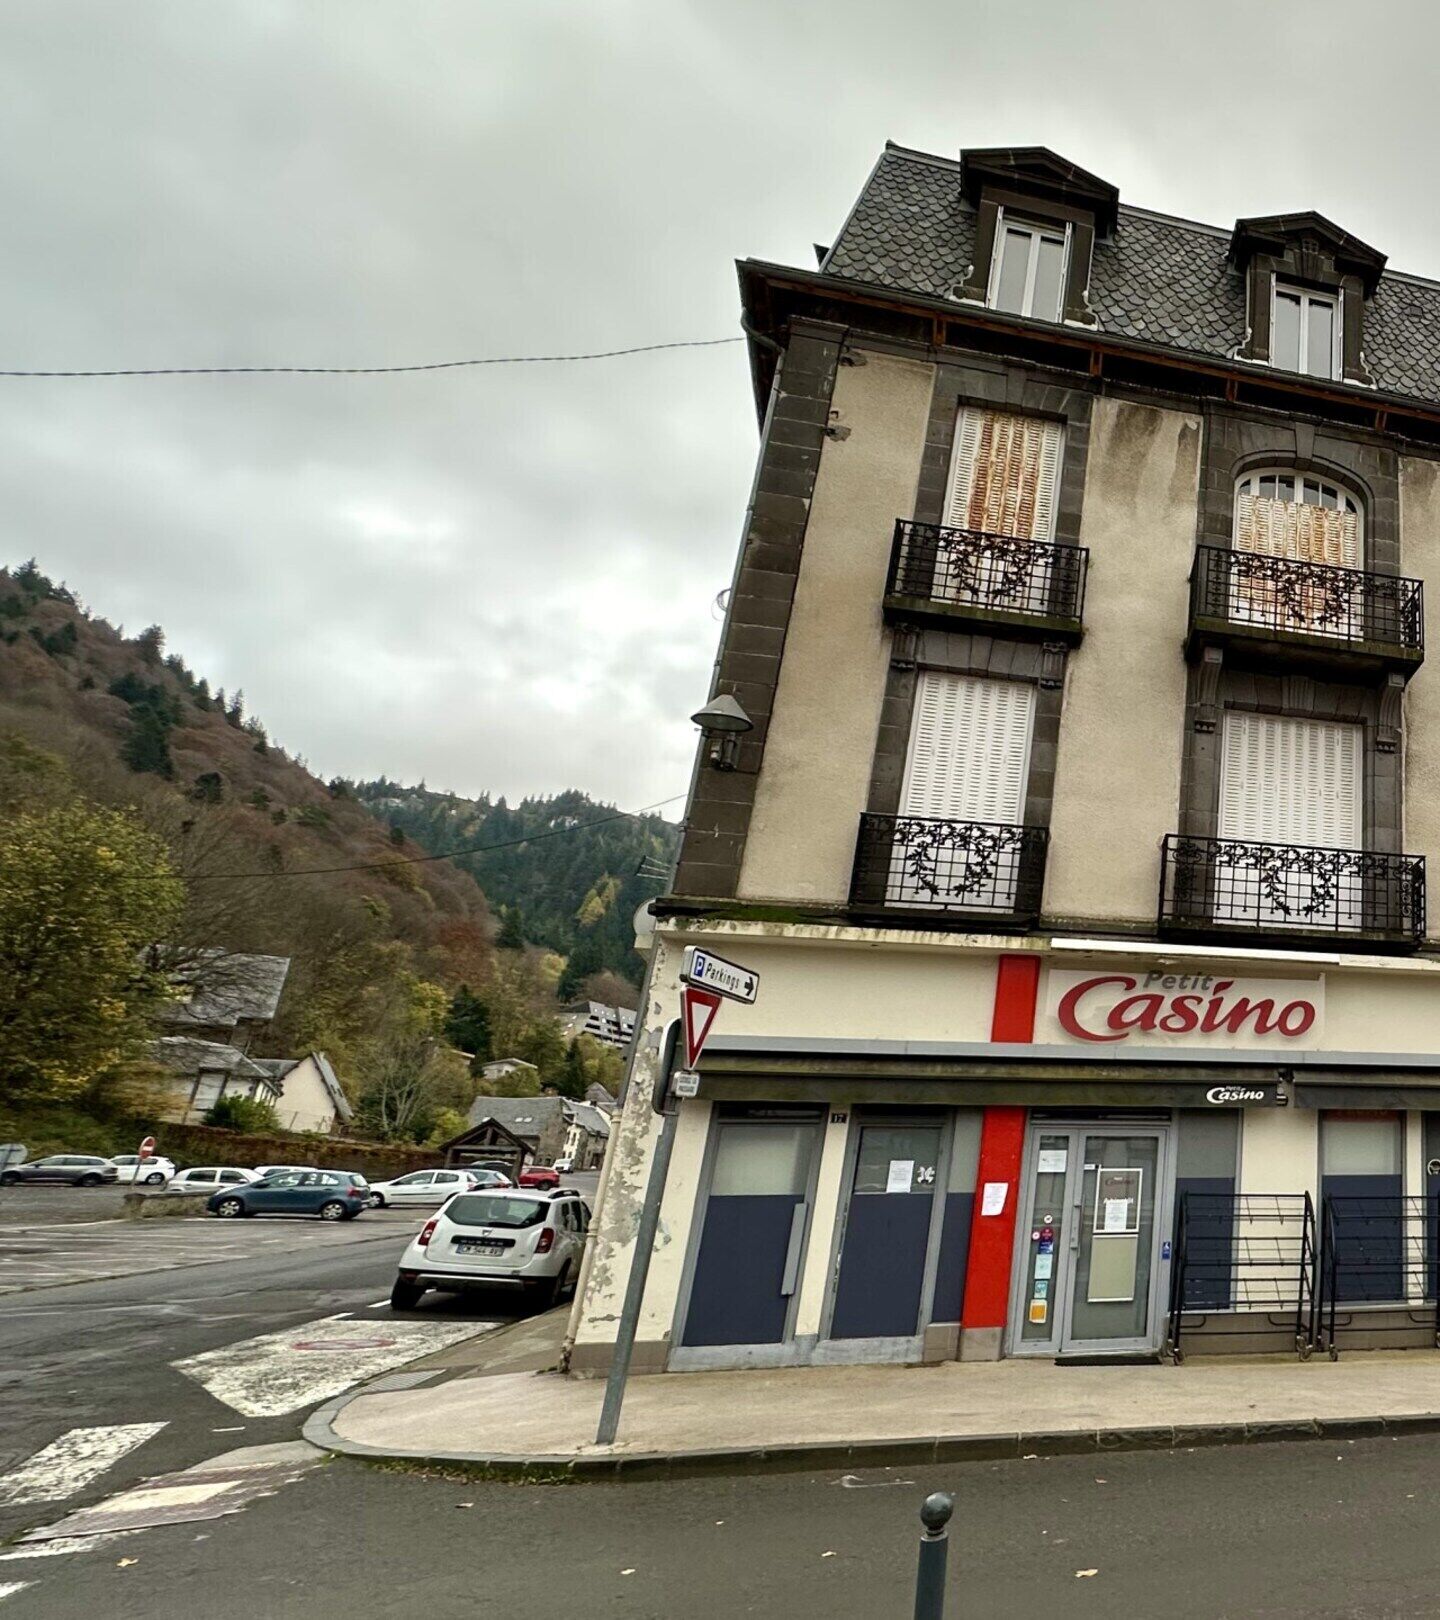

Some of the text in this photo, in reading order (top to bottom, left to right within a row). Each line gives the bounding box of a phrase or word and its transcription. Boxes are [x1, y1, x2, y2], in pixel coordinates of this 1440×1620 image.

[705, 962, 740, 991] Parkings
[1143, 969, 1213, 990] Petit
[1058, 976, 1316, 1042] Casino
[1206, 1087, 1264, 1104] Casino
